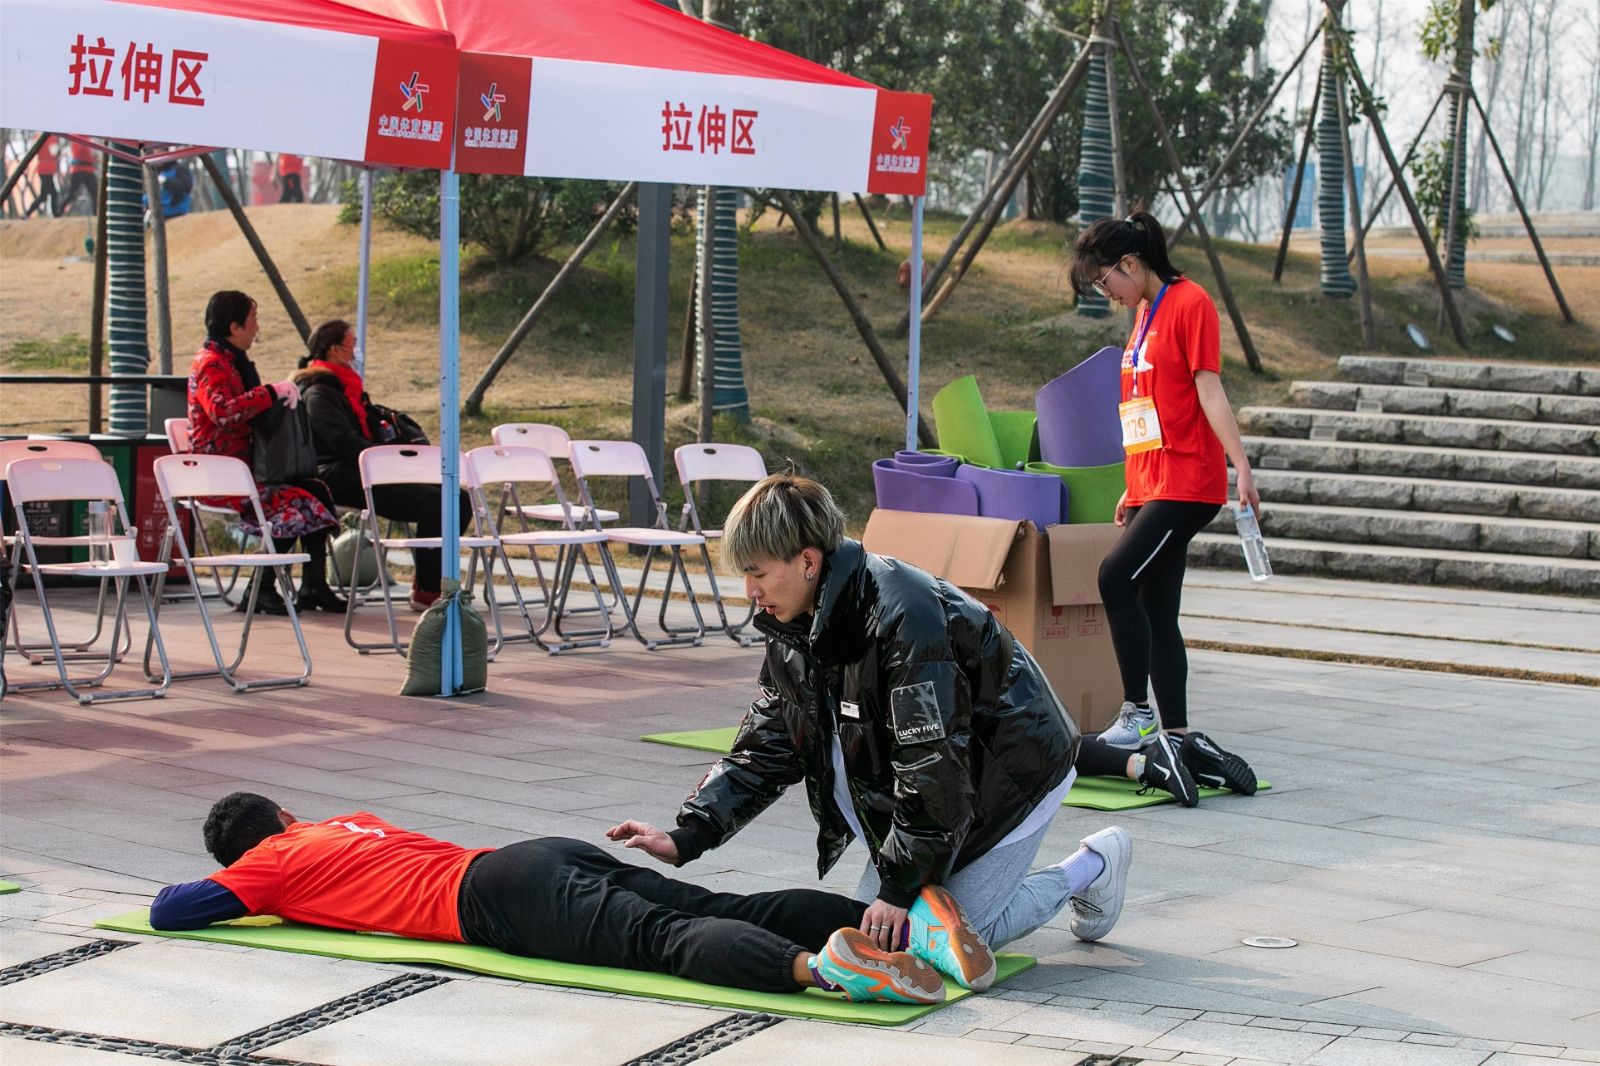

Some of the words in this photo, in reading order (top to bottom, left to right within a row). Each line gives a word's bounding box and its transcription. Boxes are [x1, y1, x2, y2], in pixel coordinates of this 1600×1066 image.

[68, 34, 209, 106] 拉伸区
[662, 101, 758, 155] 拉伸区
[899, 727, 921, 737] LUCKY
[922, 723, 940, 733] FIVE
